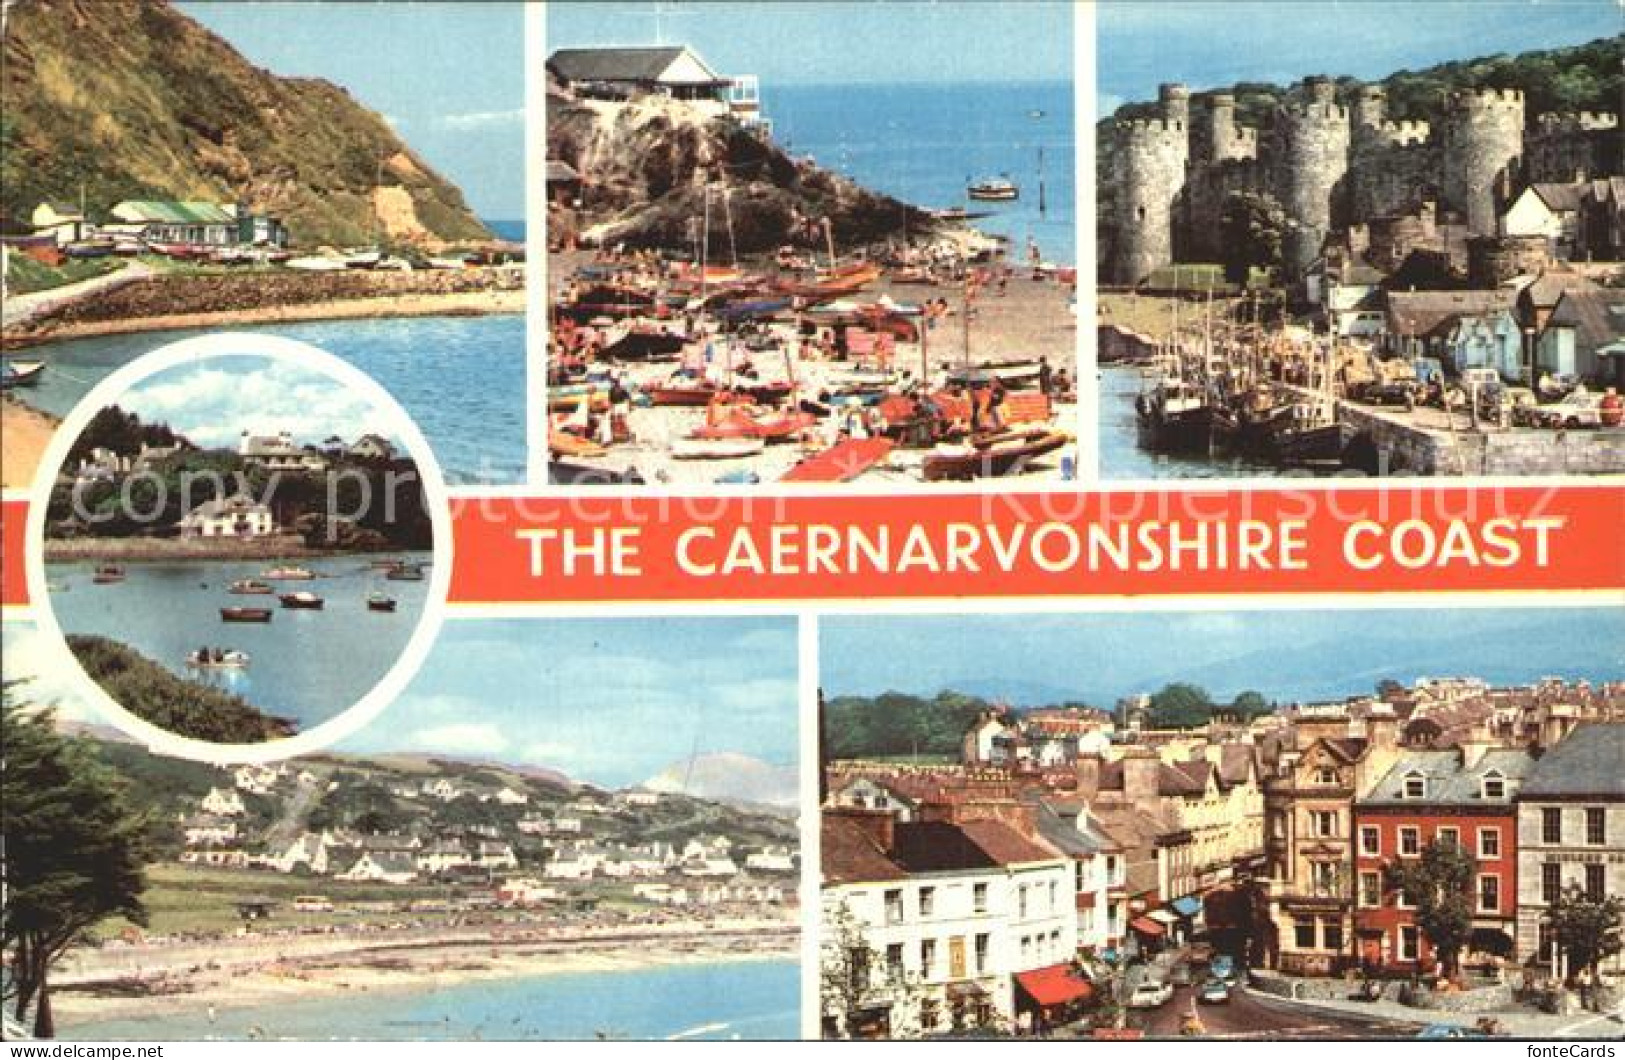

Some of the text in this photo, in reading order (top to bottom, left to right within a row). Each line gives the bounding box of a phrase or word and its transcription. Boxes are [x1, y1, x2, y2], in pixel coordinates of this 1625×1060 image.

[515, 517, 1565, 577] THE CAERNARVONSHIRE COAST
